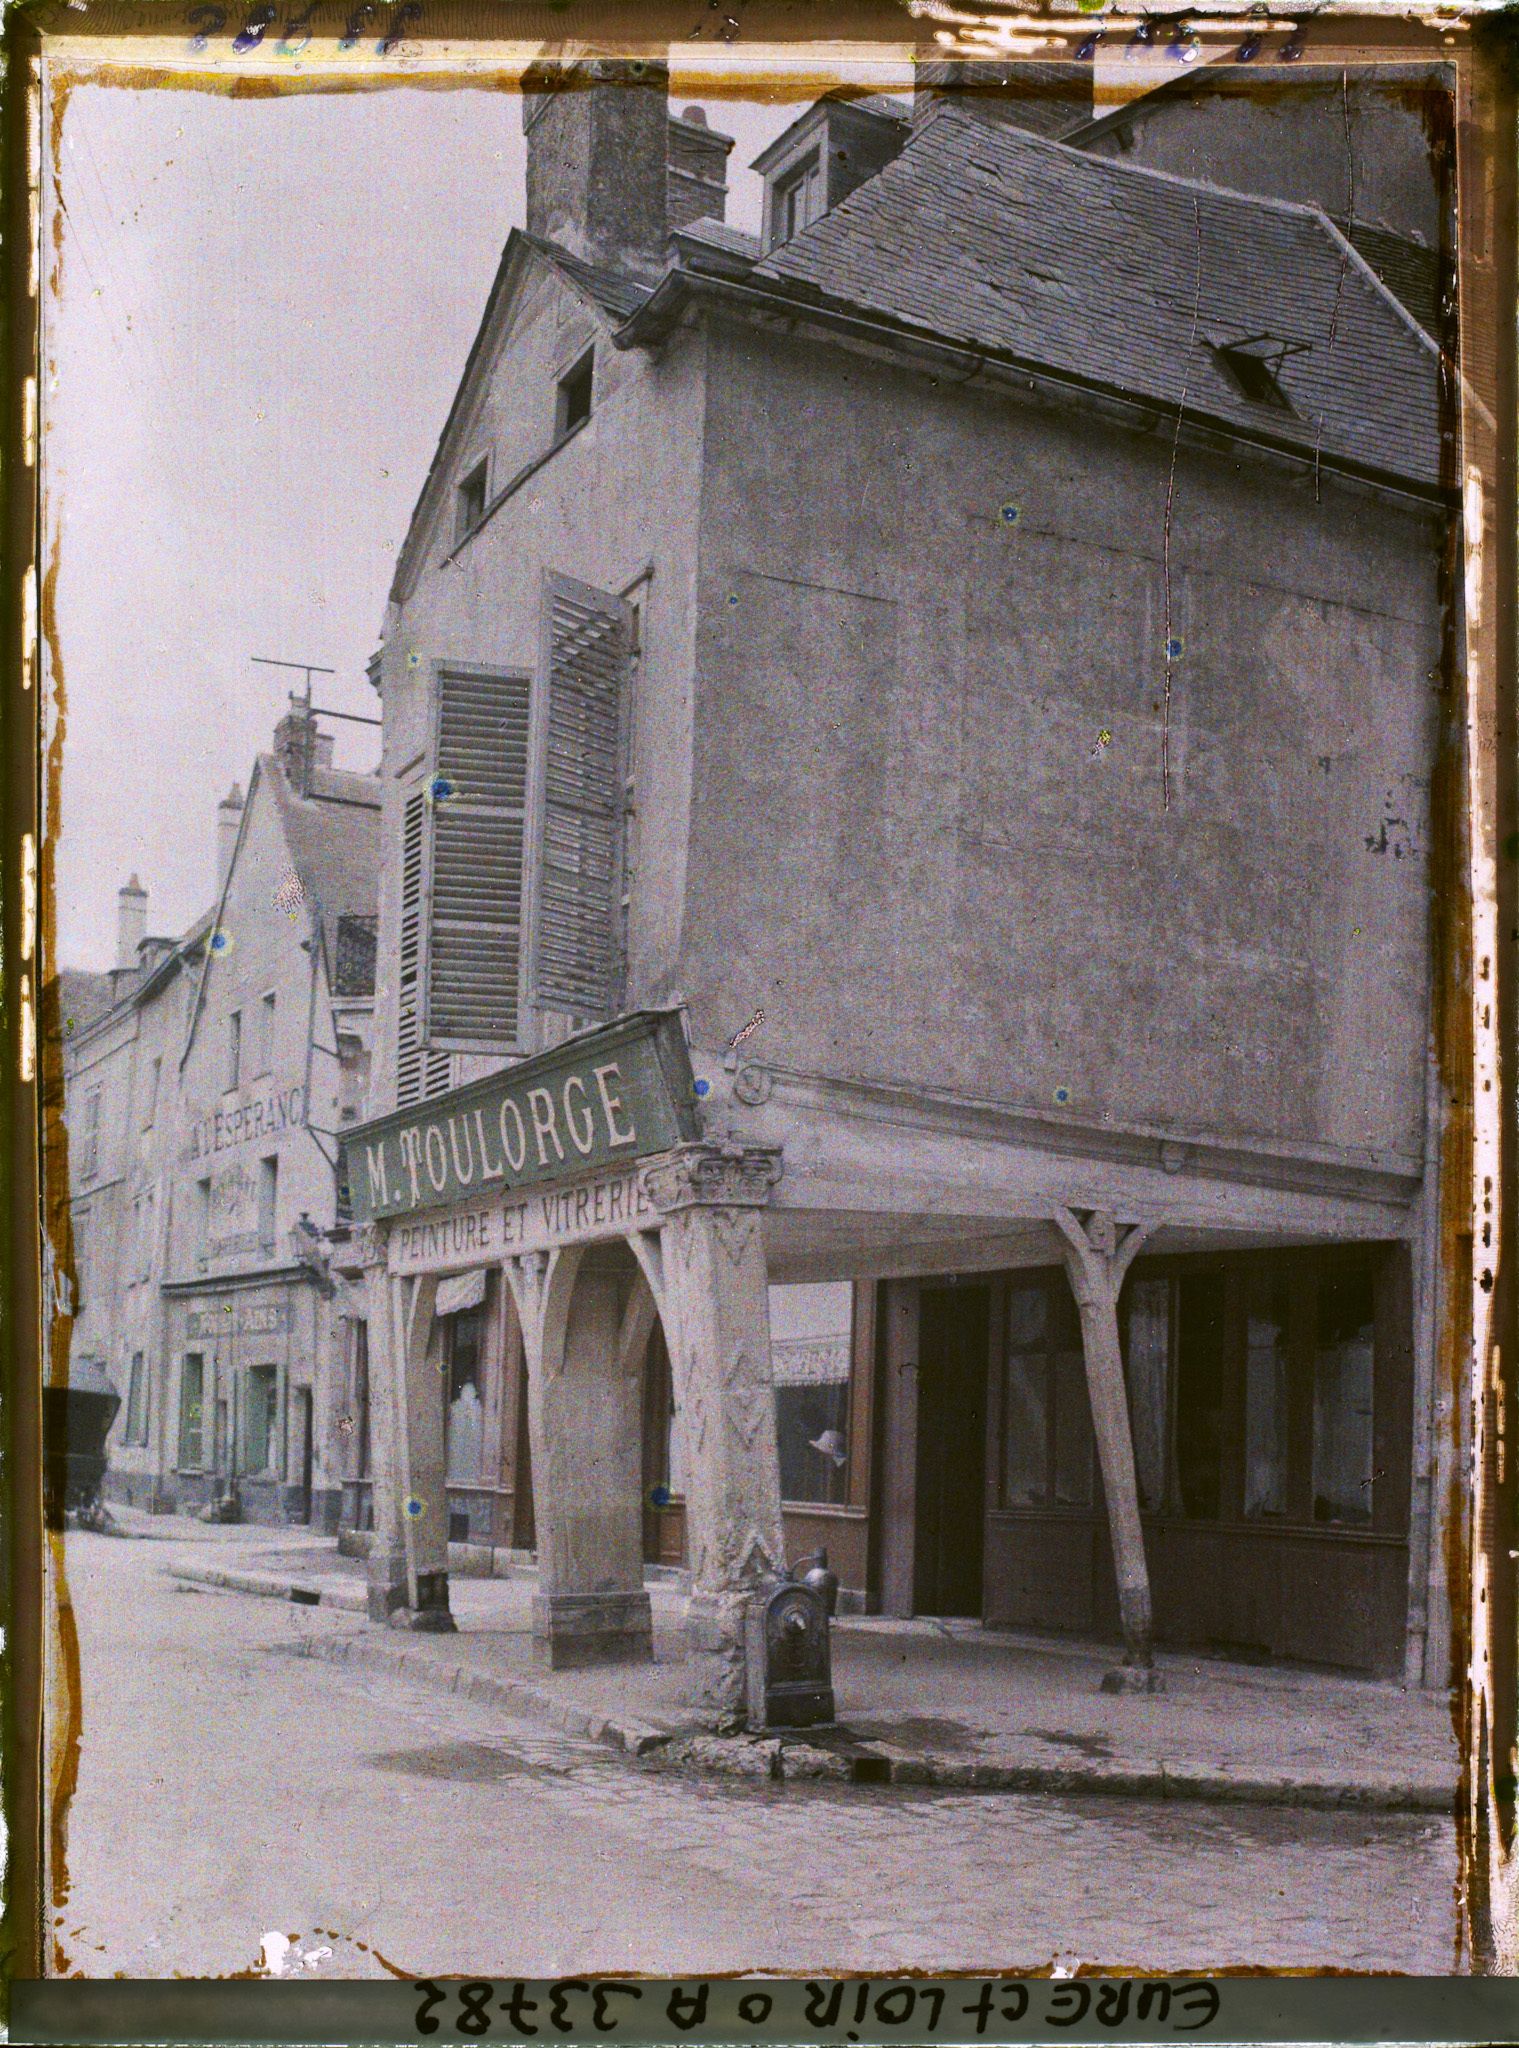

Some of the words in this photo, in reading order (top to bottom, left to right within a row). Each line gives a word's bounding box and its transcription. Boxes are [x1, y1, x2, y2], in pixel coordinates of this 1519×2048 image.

[203, 1087, 307, 1156] L'ESPERANC
[399, 1062, 636, 1208] TOULORGE
[400, 1211, 490, 1260] PEINTURE
[502, 1203, 527, 1244] ET
[542, 1173, 649, 1234] VITRERIE
[413, 1979, 643, 2037] 33782
[666, 1982, 710, 2031] A
[804, 1981, 946, 2042] LOIR
[1045, 1981, 1221, 2031] EURE
